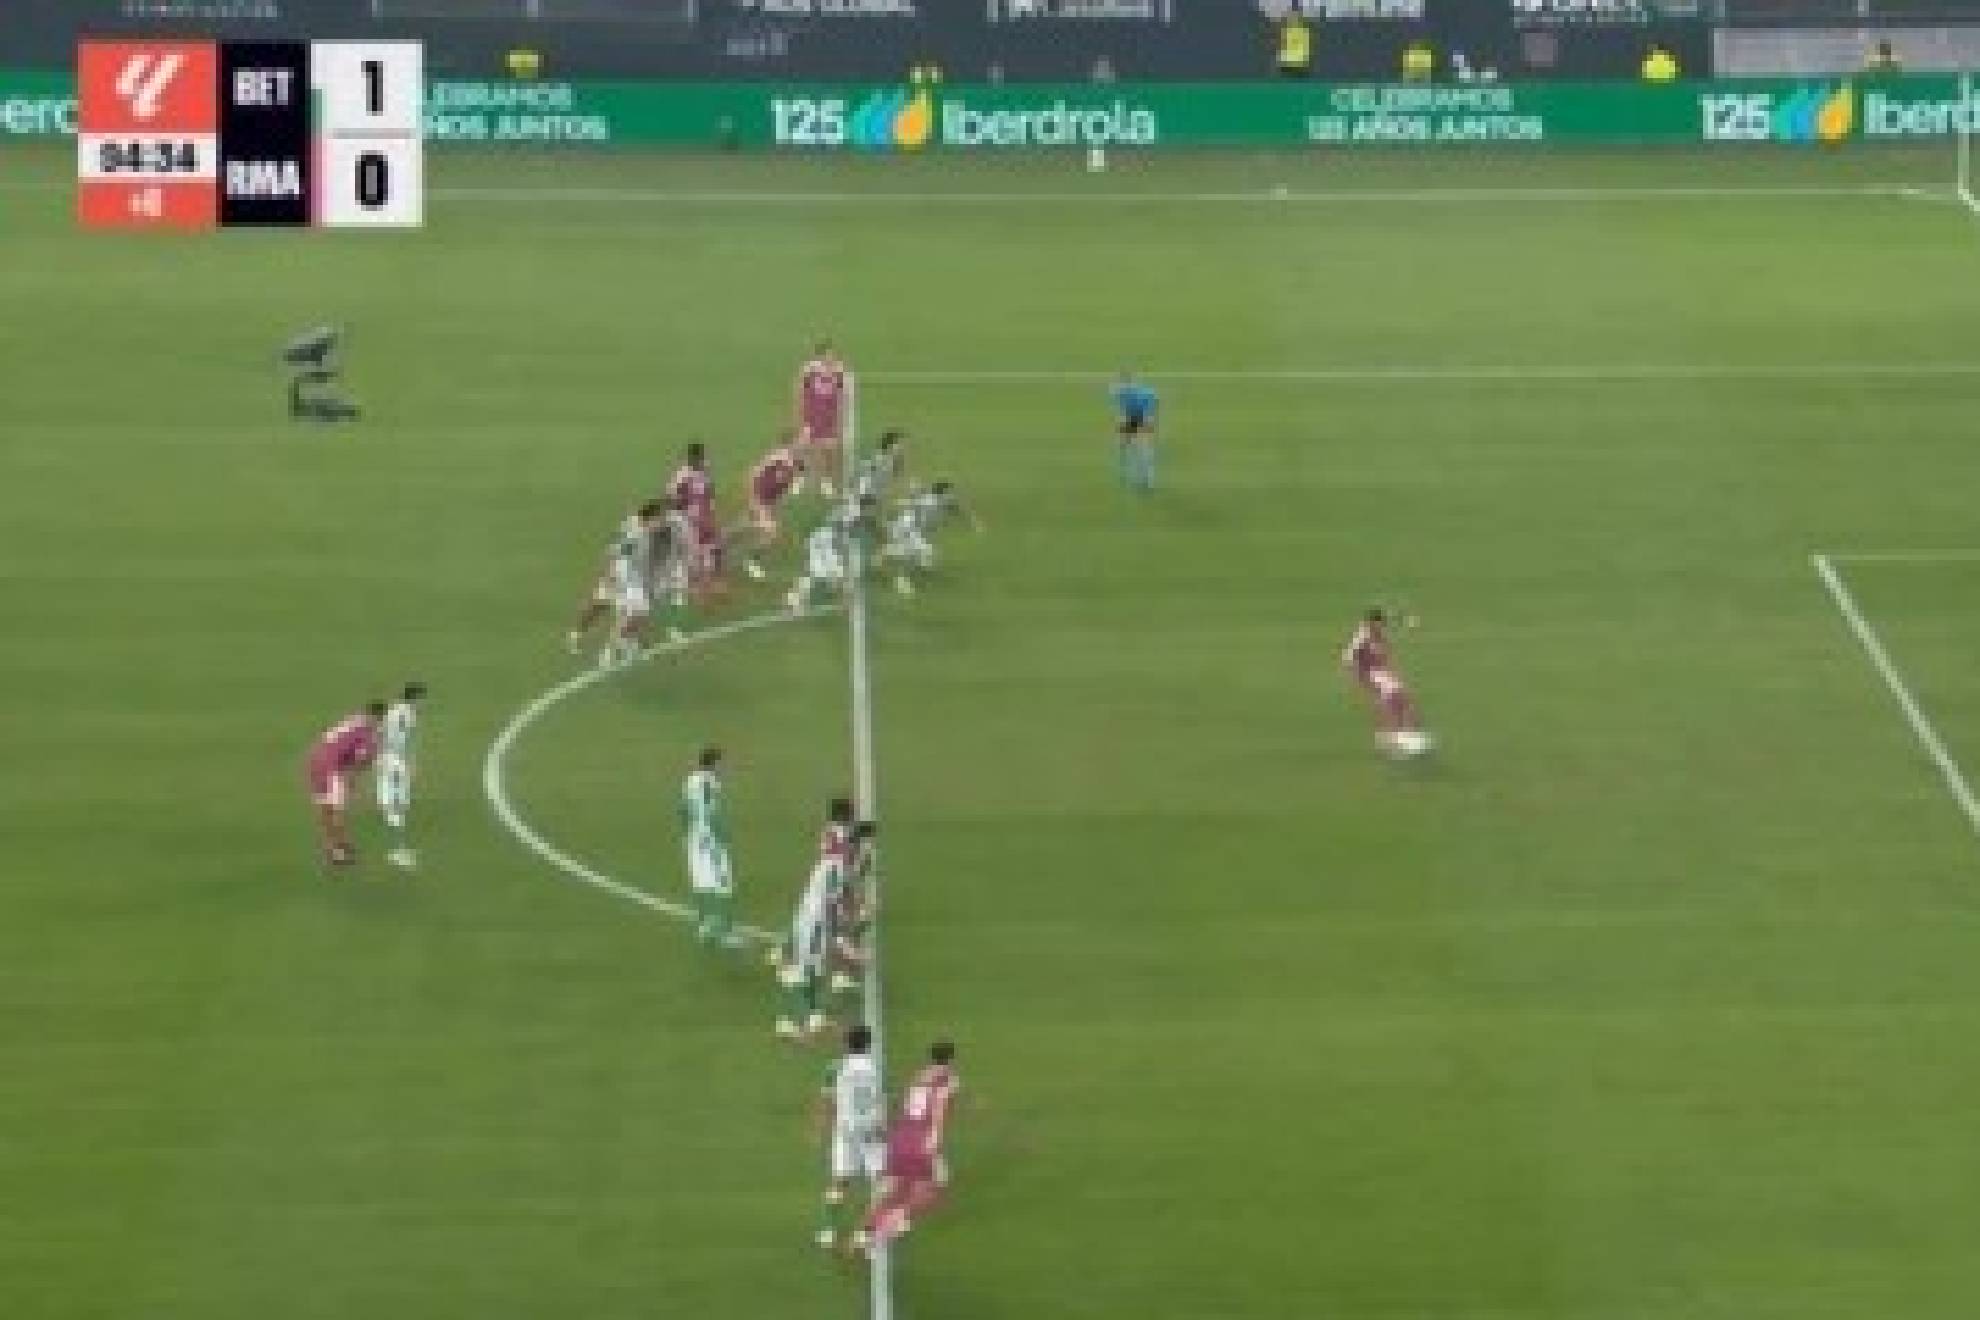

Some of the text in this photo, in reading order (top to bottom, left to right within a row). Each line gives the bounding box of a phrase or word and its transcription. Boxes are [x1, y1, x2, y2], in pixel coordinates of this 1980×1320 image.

[772, 99, 1156, 144] 125 Iberdrola
[1702, 94, 1770, 140] 125
